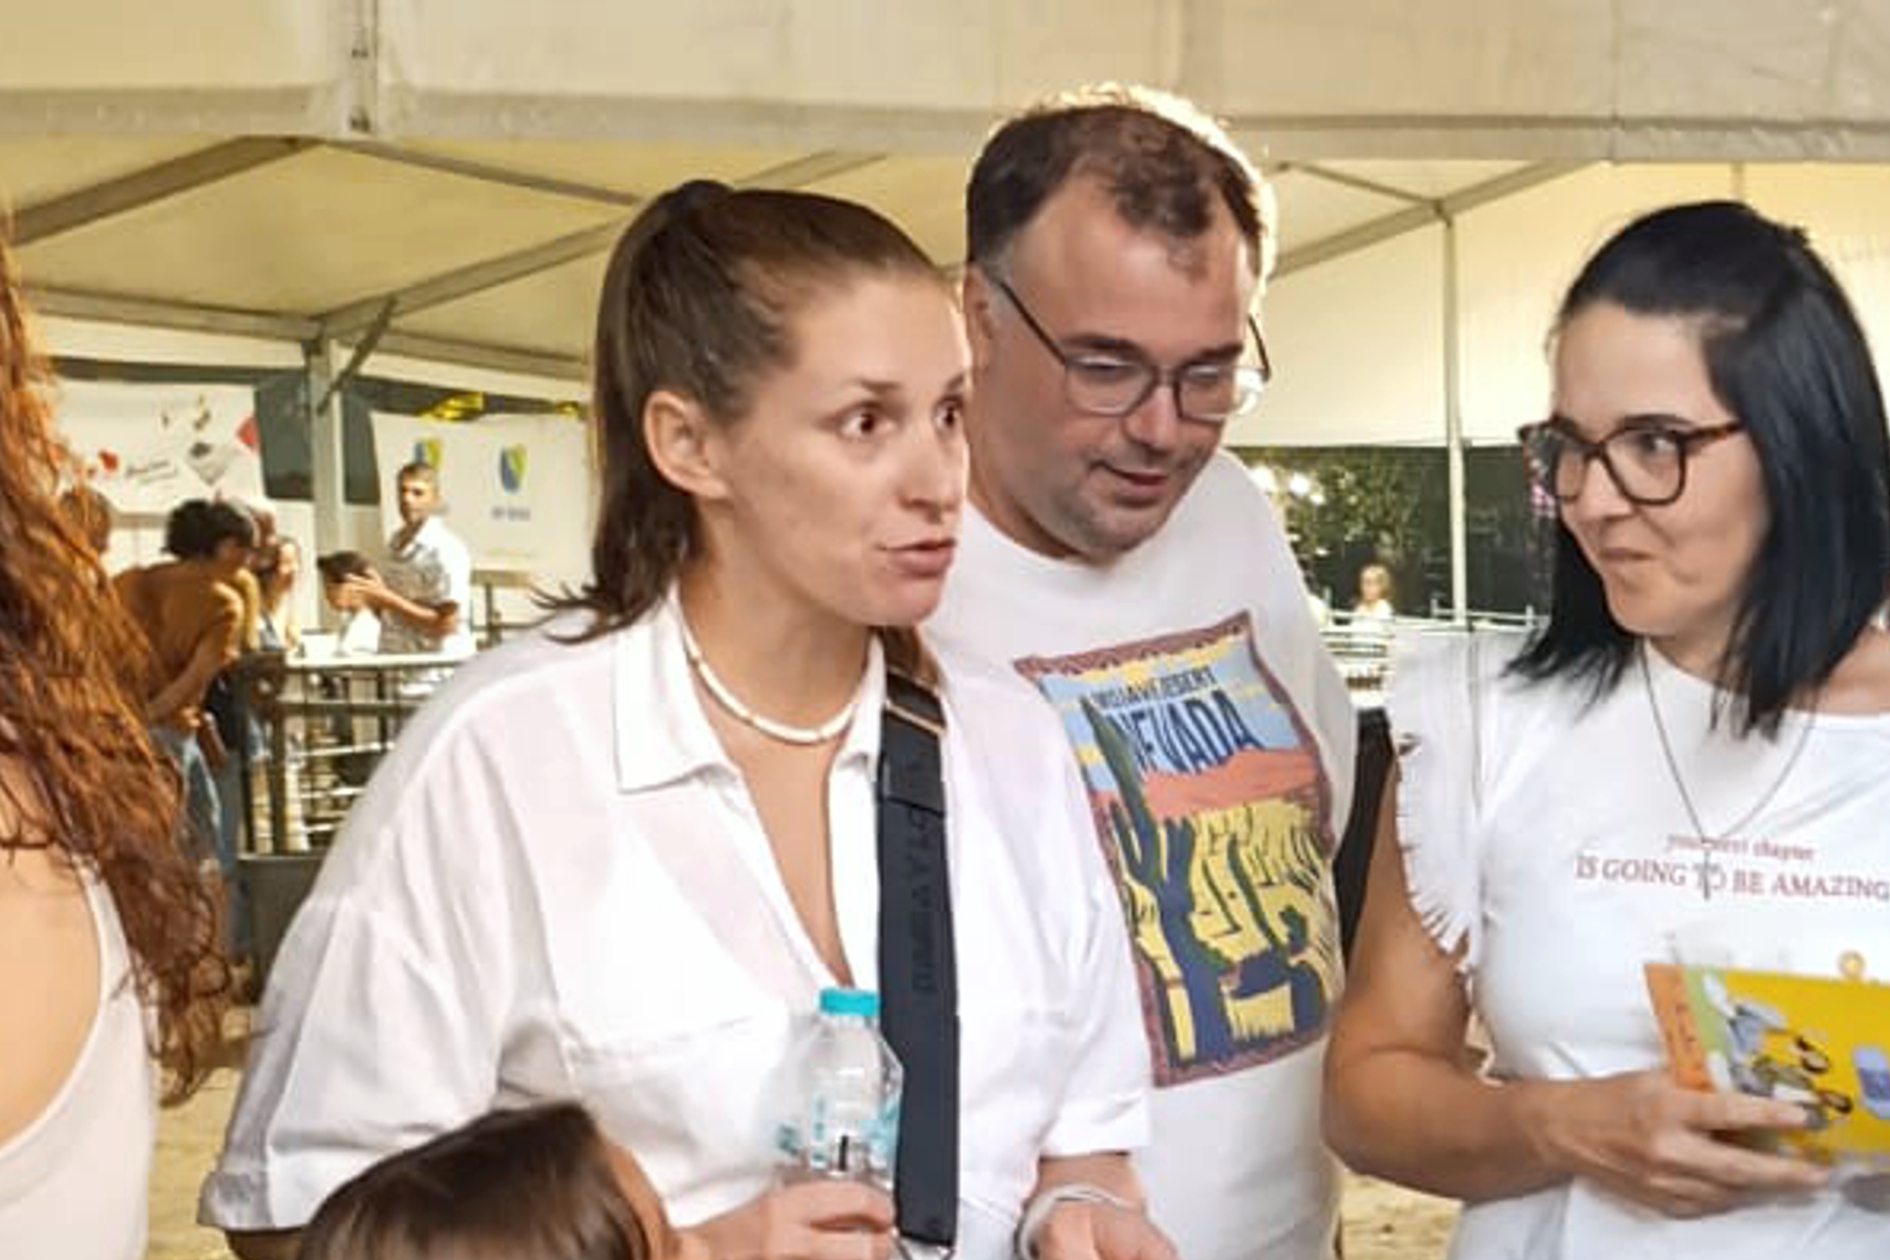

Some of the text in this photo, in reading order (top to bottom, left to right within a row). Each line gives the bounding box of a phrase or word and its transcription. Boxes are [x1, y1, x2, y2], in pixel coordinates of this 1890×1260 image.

[1106, 689, 1266, 775] NEVADA
[1575, 855, 1890, 901] IS GOING TO BE AMAZING
